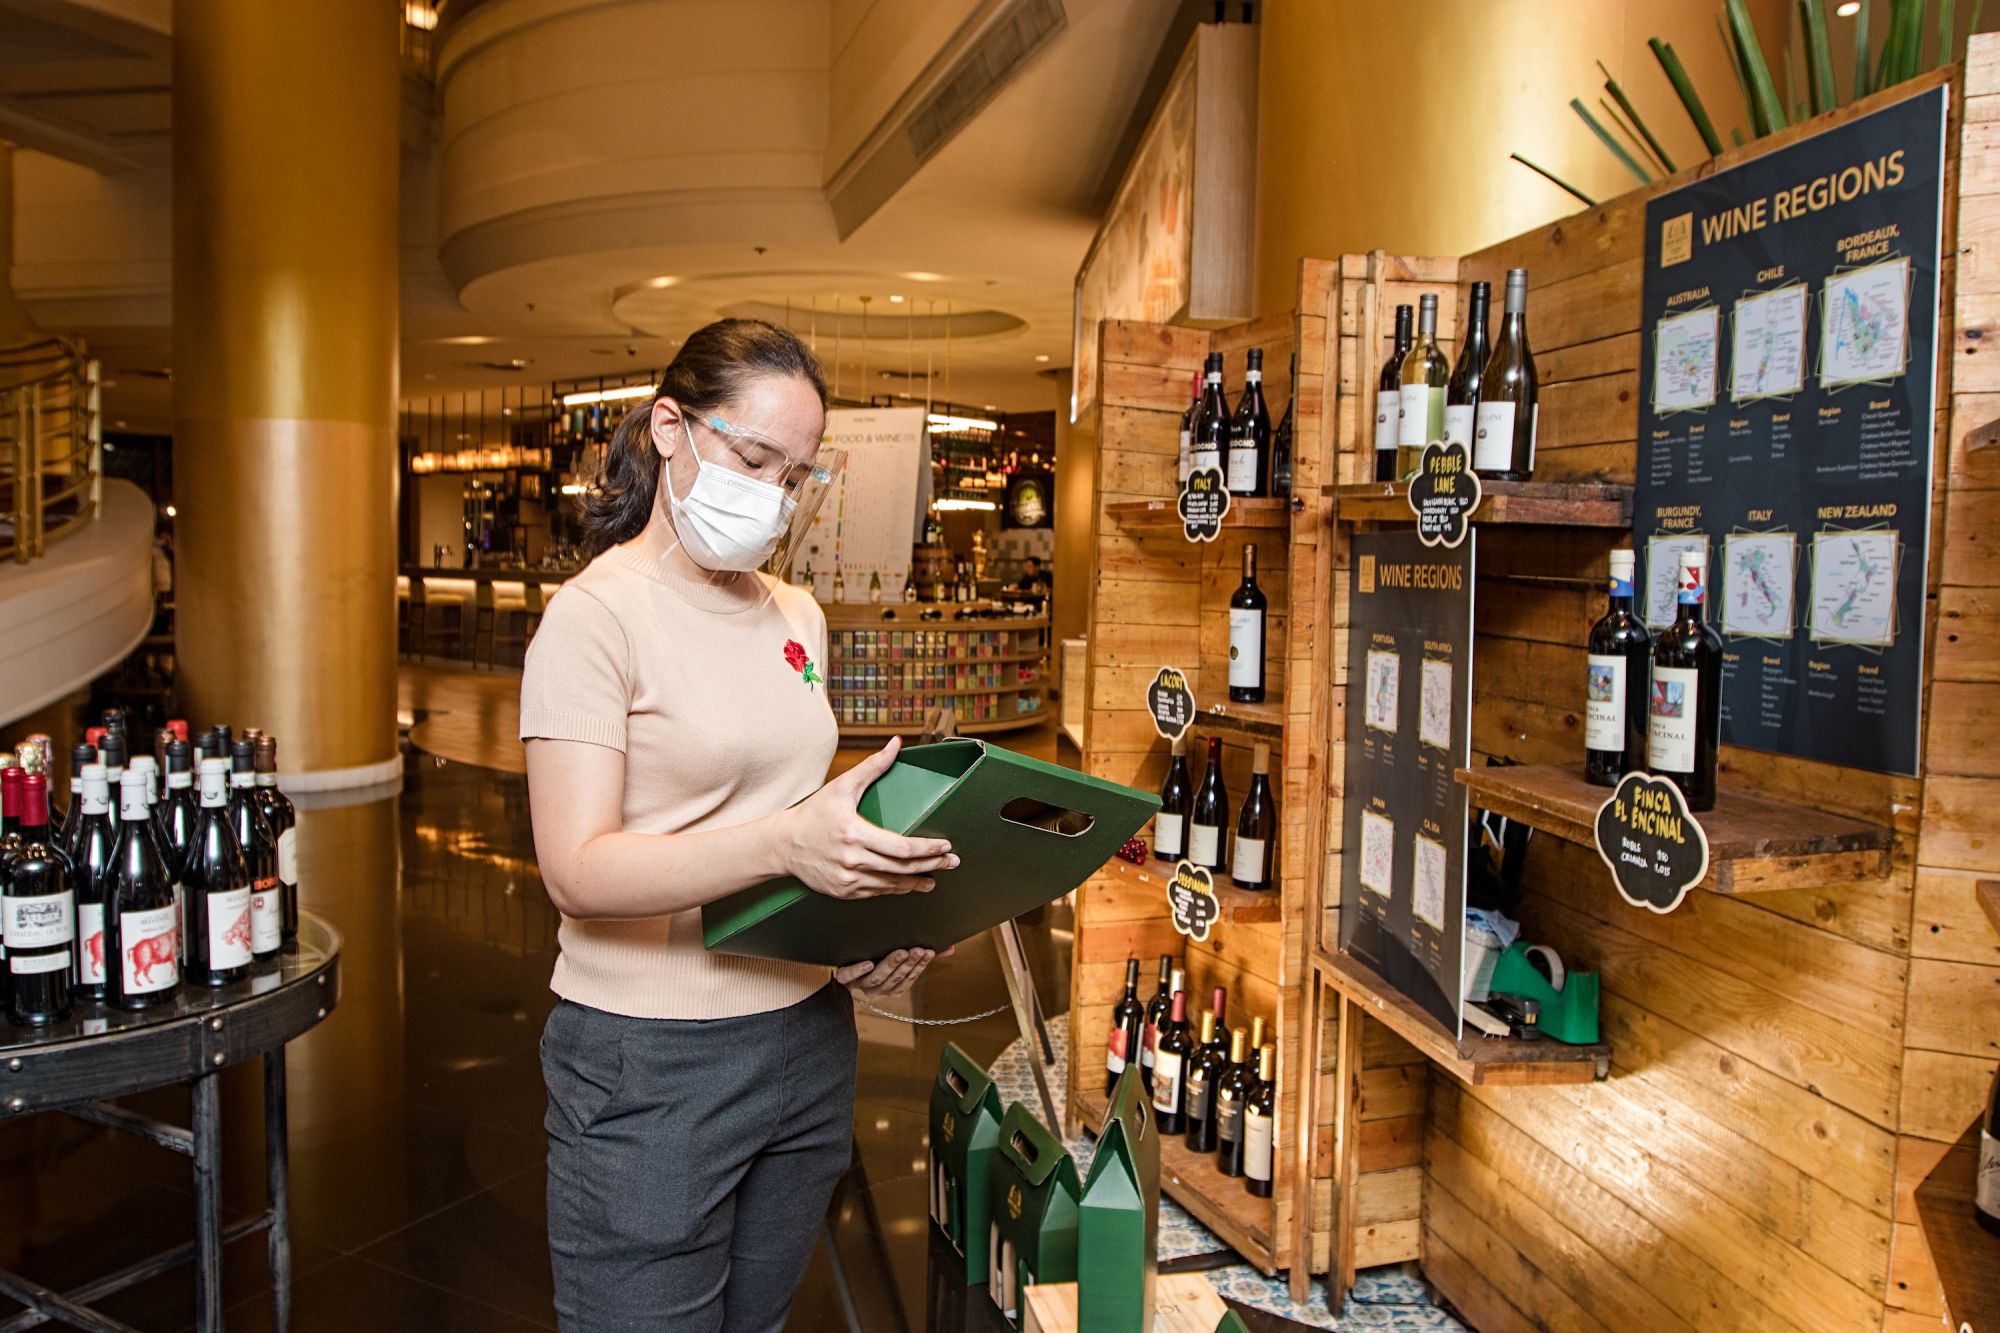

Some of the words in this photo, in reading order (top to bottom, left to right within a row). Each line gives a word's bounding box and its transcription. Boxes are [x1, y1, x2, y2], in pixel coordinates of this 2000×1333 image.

[1701, 198, 1768, 246] WINE
[1773, 150, 1906, 224] REGIONS
[1836, 224, 1901, 253] BORDEAUX,
[1845, 240, 1890, 263] FRANCE
[1756, 265, 1785, 283] CHILE
[1666, 286, 1711, 307] AUSTRALIA
[1818, 407, 1842, 418] Region
[1869, 399, 1891, 411] Brand
[834, 433, 863, 444] FOOD
[865, 433, 873, 443] &
[875, 432, 900, 443] WINE
[1430, 453, 1463, 474] PEBBLE
[1194, 477, 1212, 491] ITALY
[1434, 476, 1456, 494] LANE
[1656, 505, 1702, 518] BURGUNDY,
[1748, 509, 1773, 522] ITALY
[1818, 506, 1844, 520] NEW
[1845, 503, 1898, 519] ZEALAND
[1662, 517, 1695, 529] FRANCE
[1380, 563, 1412, 588] WINE
[1413, 563, 1462, 590] REGIONS
[1373, 633, 1396, 645] PORTUGAL
[1424, 640, 1438, 651] SOUTH
[1438, 642, 1452, 654] AFRICA
[1808, 659, 1831, 672] Region
[1858, 664, 1880, 676] Brand
[1372, 796, 1386, 809] SPAIN
[1634, 785, 1671, 815] FINCA
[1614, 798, 1627, 822] EL
[1631, 805, 1685, 843] ENCINAL
[1621, 836, 1641, 853] ROBLE
[1621, 851, 1648, 869] CRIANZA
